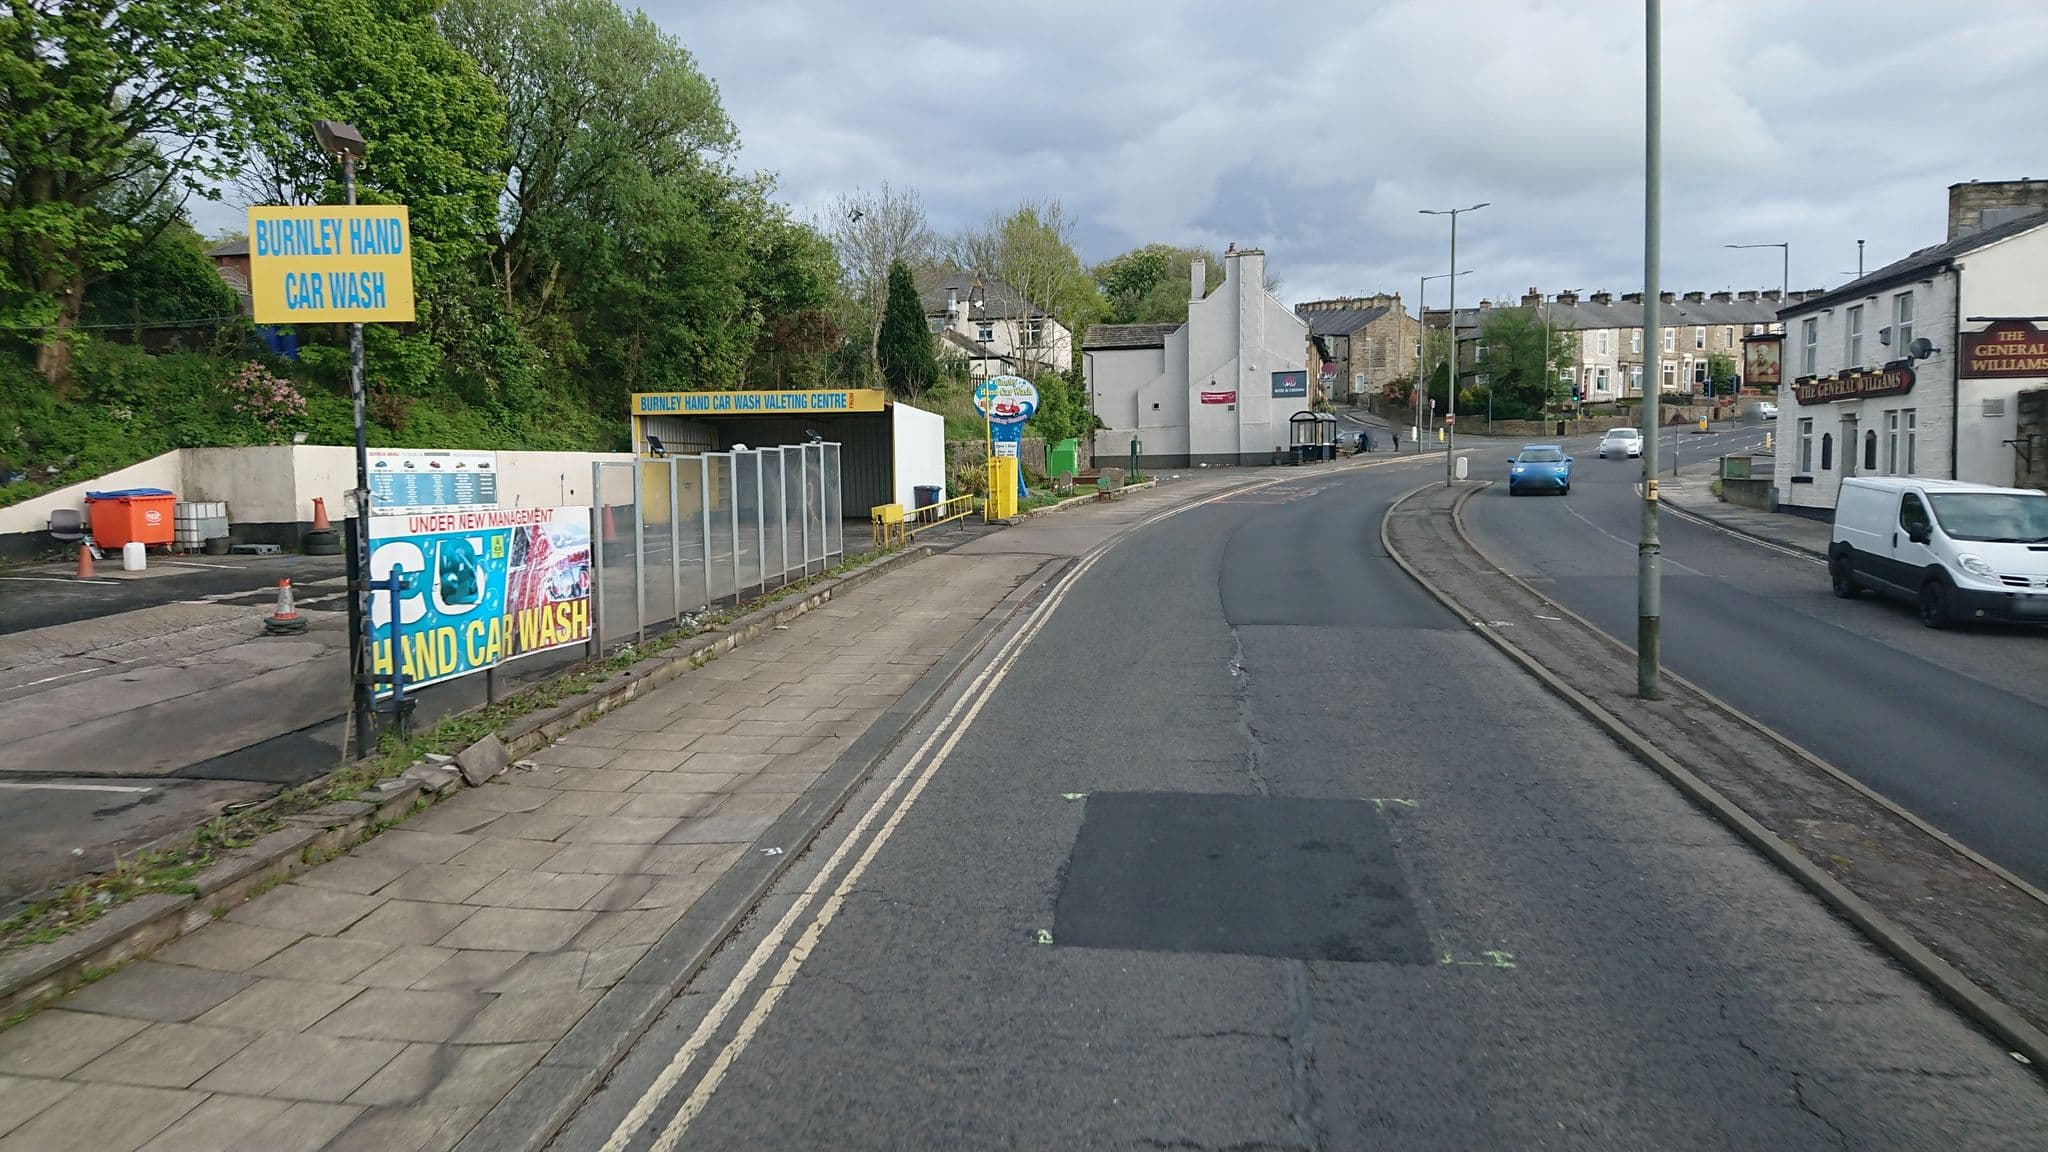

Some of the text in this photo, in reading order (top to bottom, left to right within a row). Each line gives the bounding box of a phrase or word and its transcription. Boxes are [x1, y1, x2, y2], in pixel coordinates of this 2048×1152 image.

[256, 218, 402, 256] BURNLEY HAND
[285, 272, 386, 309] CAR WASH
[1998, 331, 2025, 341] THE
[1975, 344, 2048, 356] GENERAL
[1970, 358, 2048, 371] WILLIAMS
[1801, 385, 1816, 399] THE
[1818, 379, 1856, 397] GENERAL
[641, 393, 847, 411] BURNLEY HAND CAR WASH VALETING CENTRE
[410, 508, 553, 533] UNDER NEW MANAGEMENT
[373, 599, 588, 692] HAND CAR WASH
